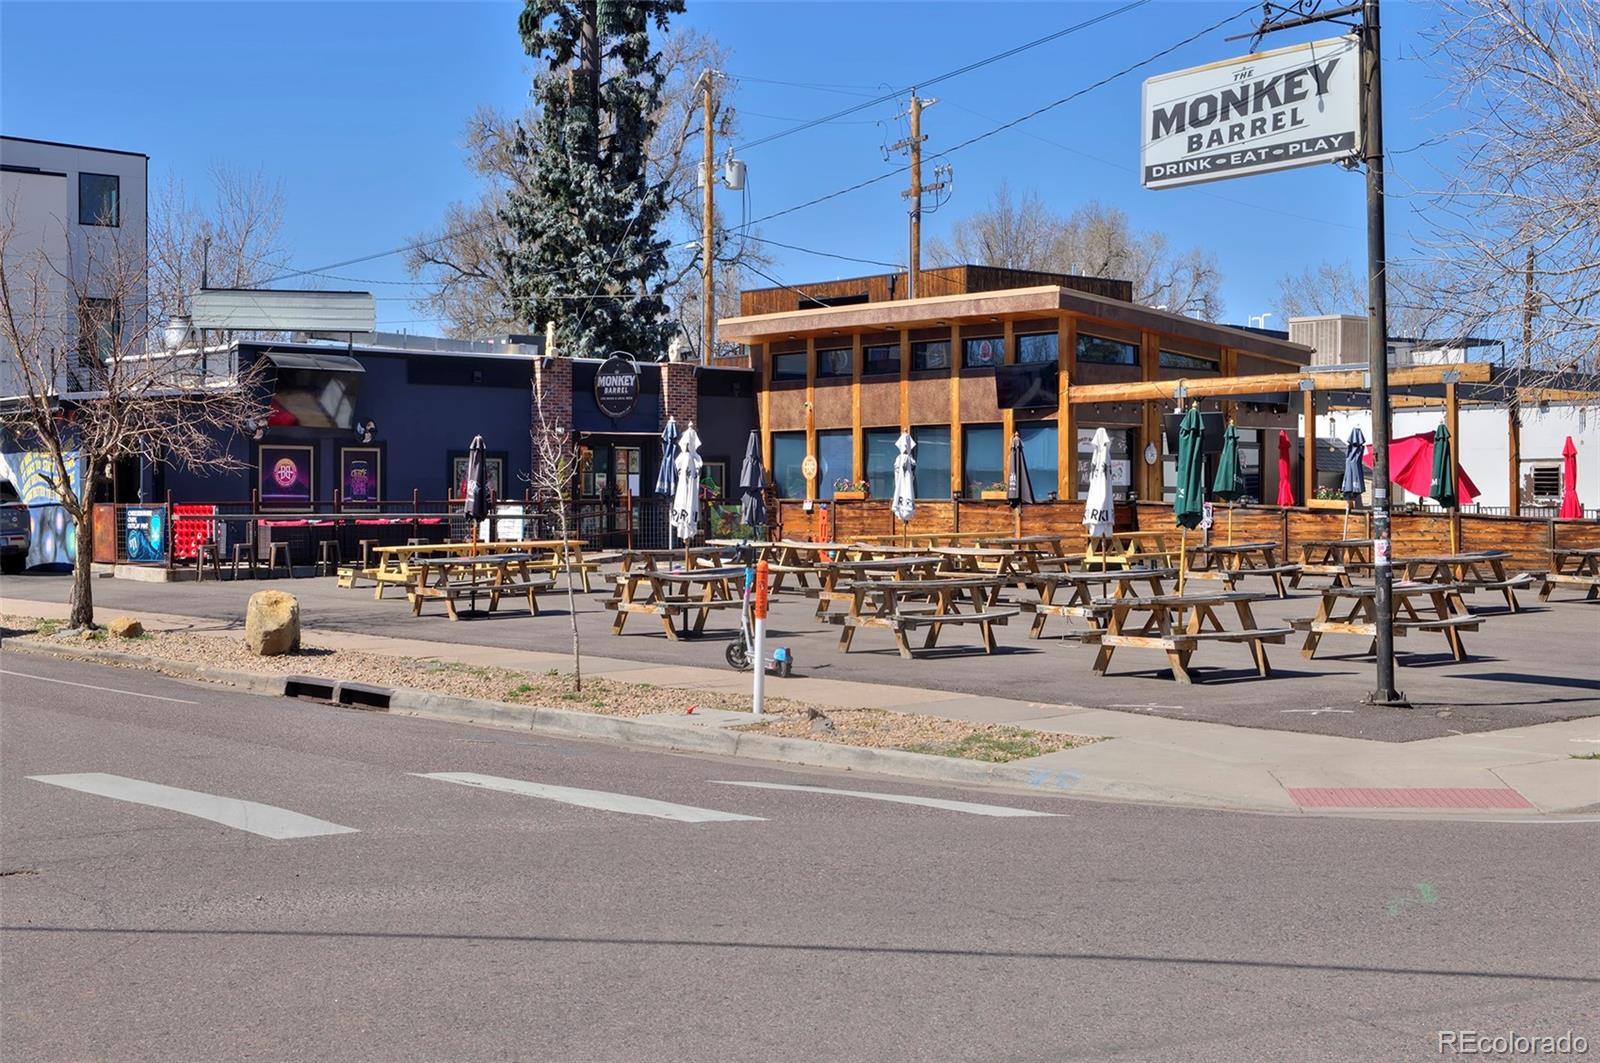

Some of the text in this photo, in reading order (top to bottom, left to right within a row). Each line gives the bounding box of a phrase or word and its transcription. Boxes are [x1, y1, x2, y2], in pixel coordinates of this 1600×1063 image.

[1233, 69, 1254, 82] THE
[1151, 57, 1341, 141] MONKEY
[1186, 106, 1305, 154] BARREL
[1151, 135, 1344, 178] DRINK EAT PLAY
[597, 375, 636, 387] MONKEY
